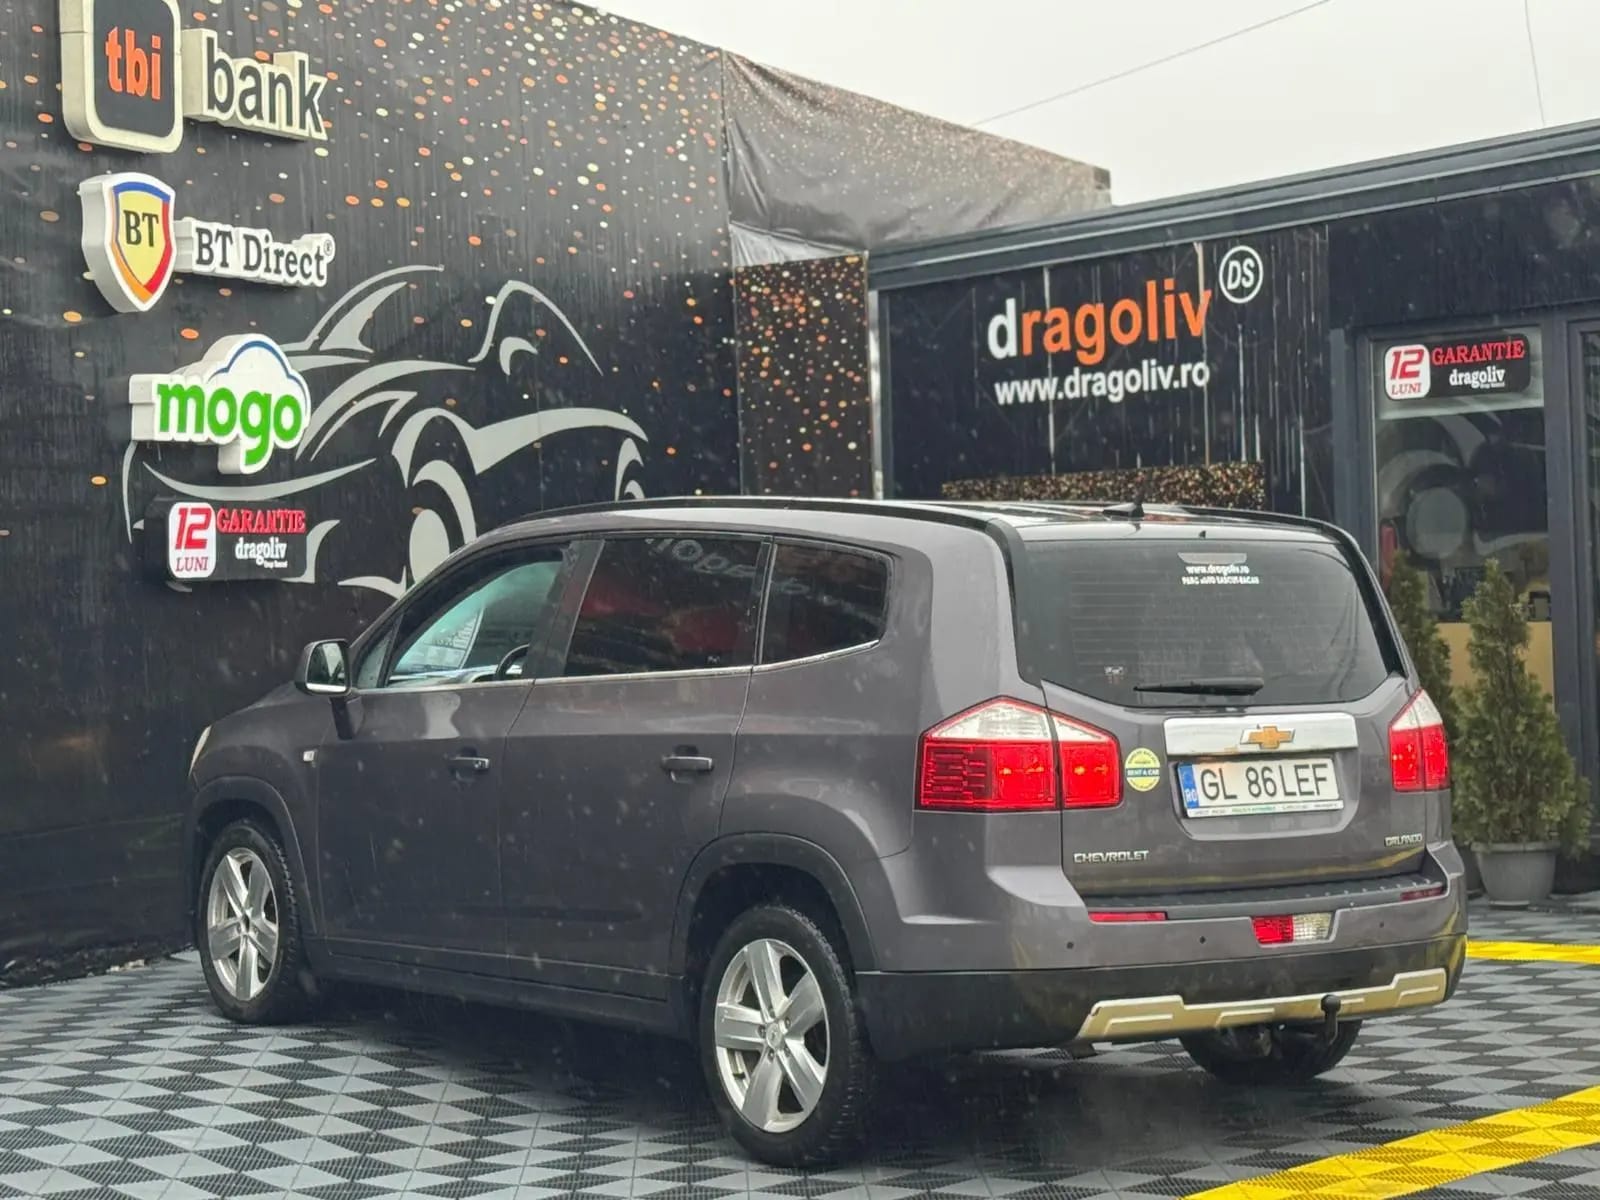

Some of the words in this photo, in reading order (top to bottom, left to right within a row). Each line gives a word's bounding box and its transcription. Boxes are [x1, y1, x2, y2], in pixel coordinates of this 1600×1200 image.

[105, 26, 162, 100] tbi
[206, 36, 322, 134] bank
[123, 209, 159, 247] BT
[195, 227, 233, 268] BT
[1227, 257, 1255, 291] DS
[987, 278, 1212, 365] dragoliv
[1390, 348, 1425, 381] 12
[1431, 339, 1526, 366] GARANTIE
[994, 359, 1211, 405] www.dragoliv.ro
[1391, 382, 1422, 396] LUNI
[1449, 365, 1506, 389] dragoliv
[157, 383, 302, 466] mogo
[175, 507, 212, 550] 12
[216, 507, 307, 534] GARANTIE
[175, 556, 209, 572] LUNI
[235, 536, 287, 566] dragoliv
[1200, 768, 1237, 800] GL
[1073, 850, 1149, 863] CHEVROLET
